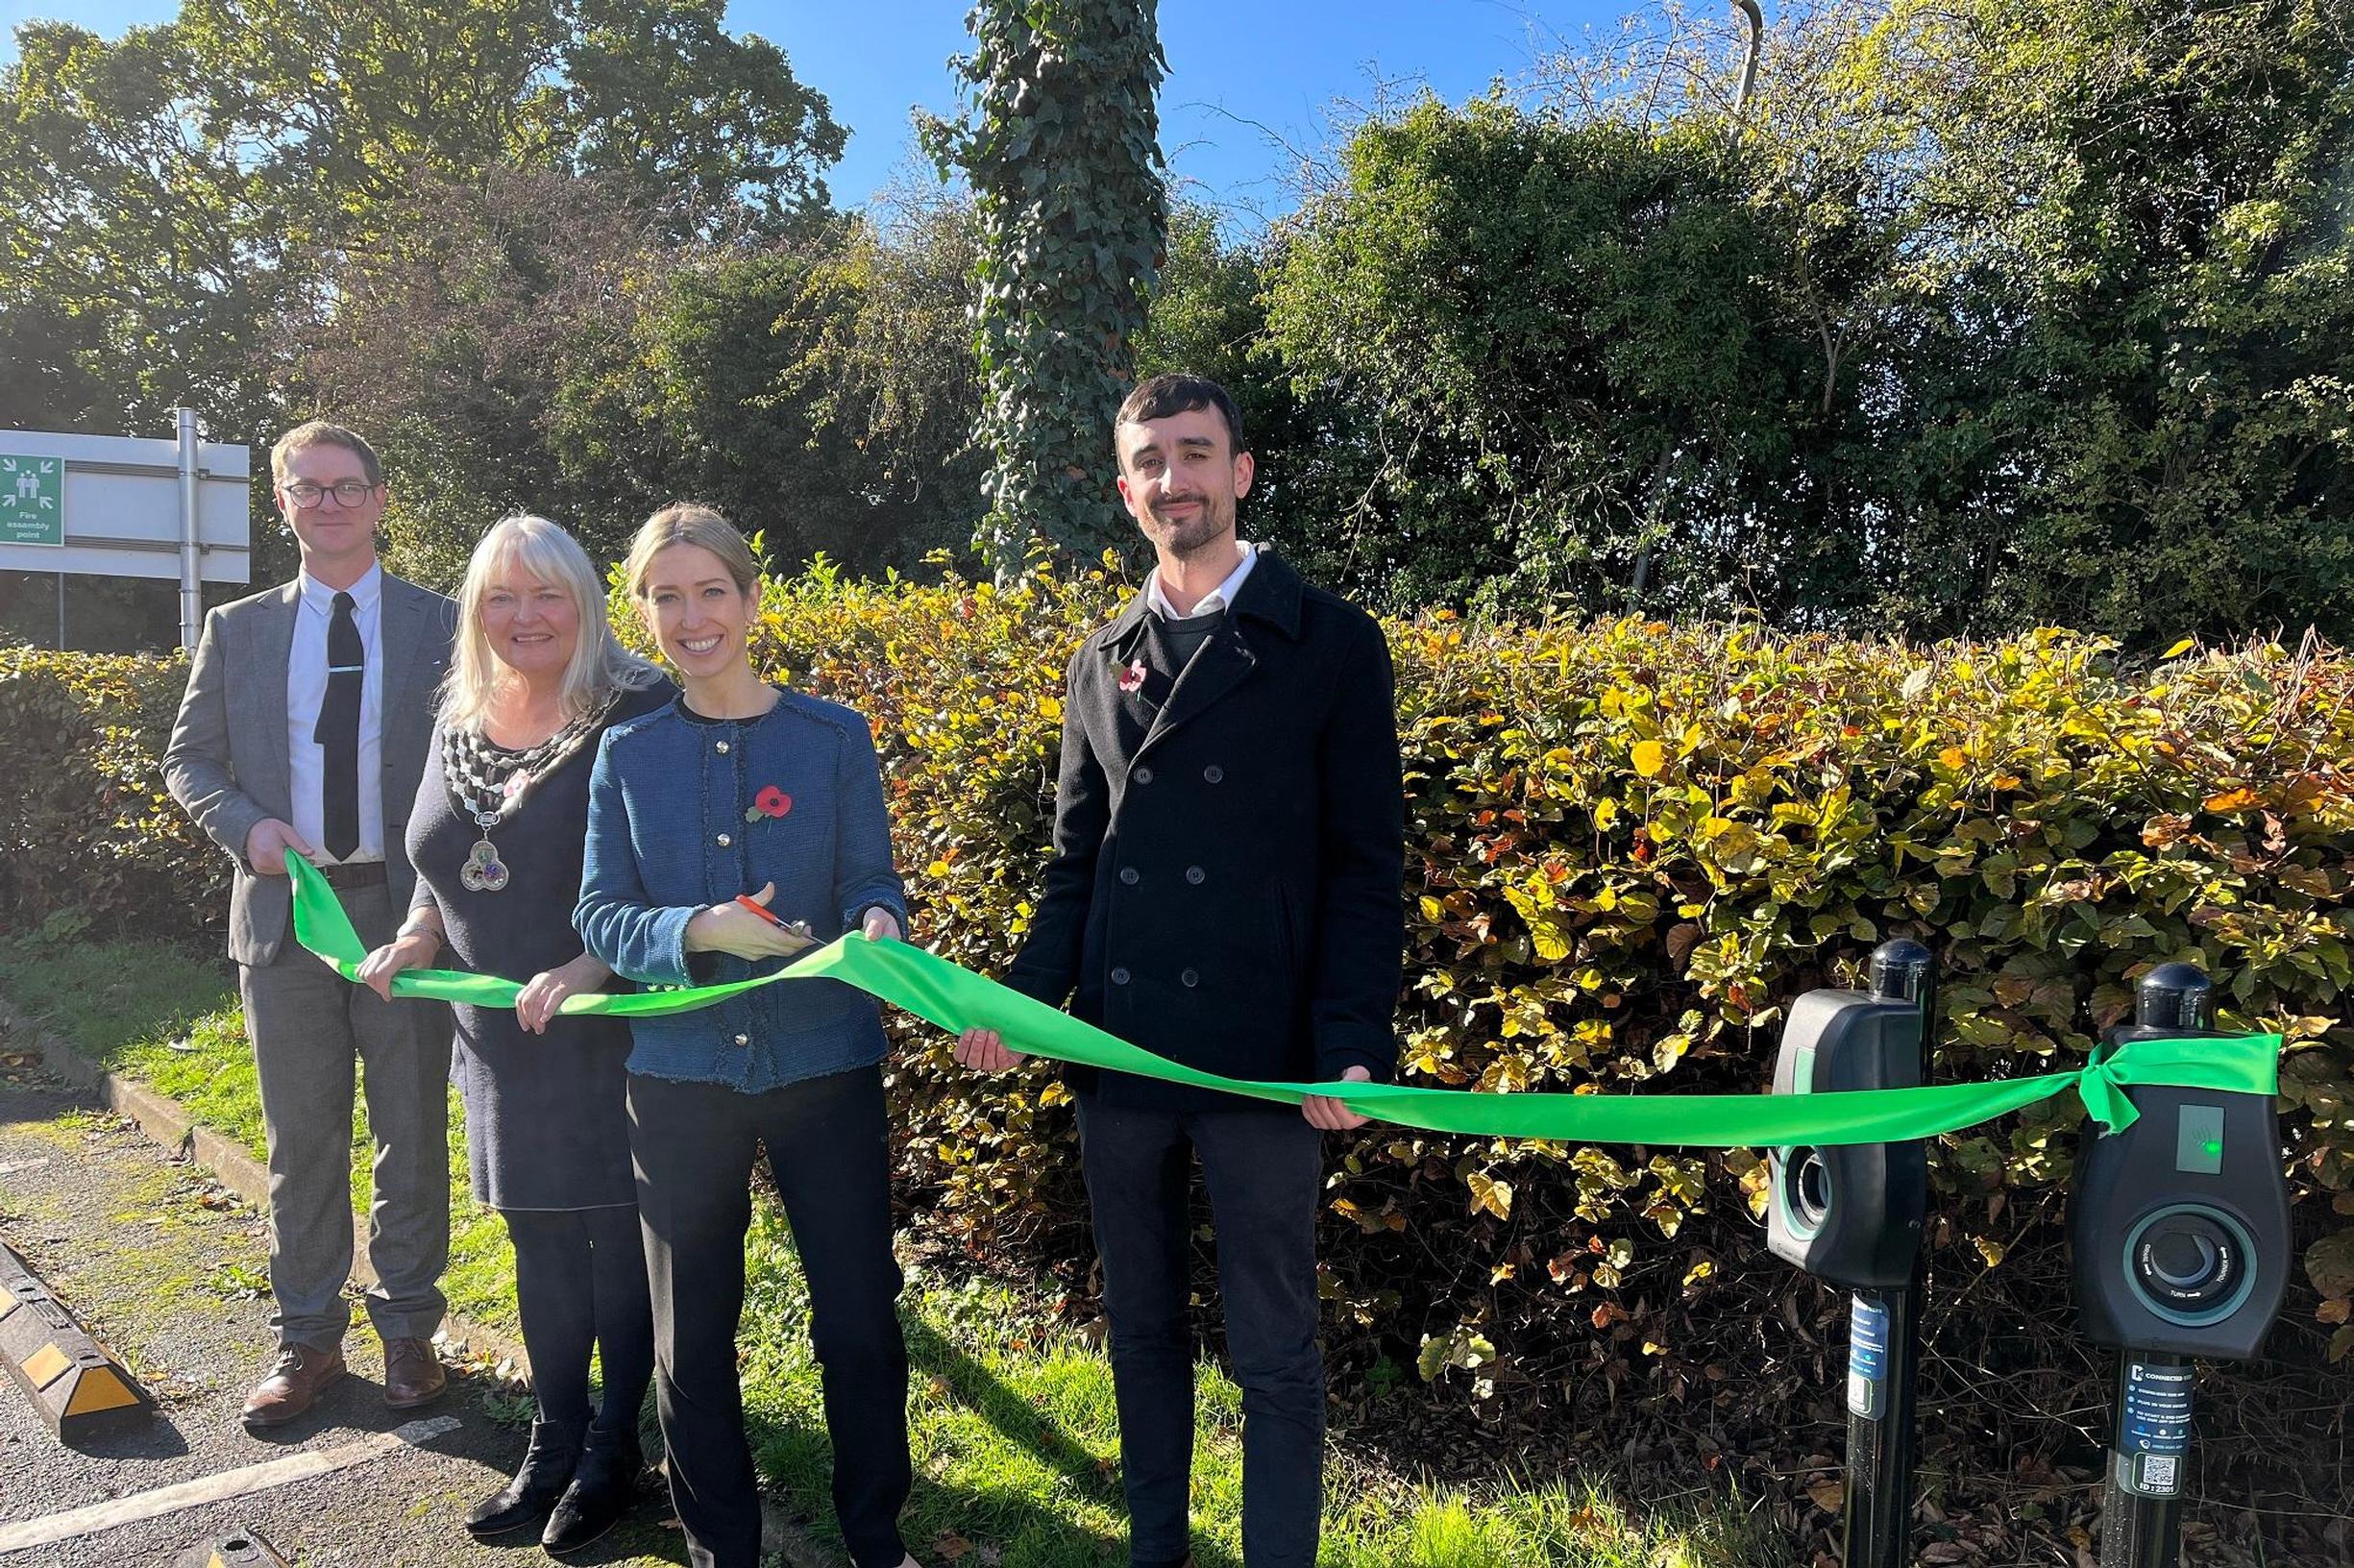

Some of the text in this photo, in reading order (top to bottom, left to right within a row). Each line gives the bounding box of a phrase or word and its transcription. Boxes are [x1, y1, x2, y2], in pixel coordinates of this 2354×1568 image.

[19, 511, 37, 520] Fire
[7, 522, 50, 531] assembly
[2139, 1482, 2150, 1491] ID
